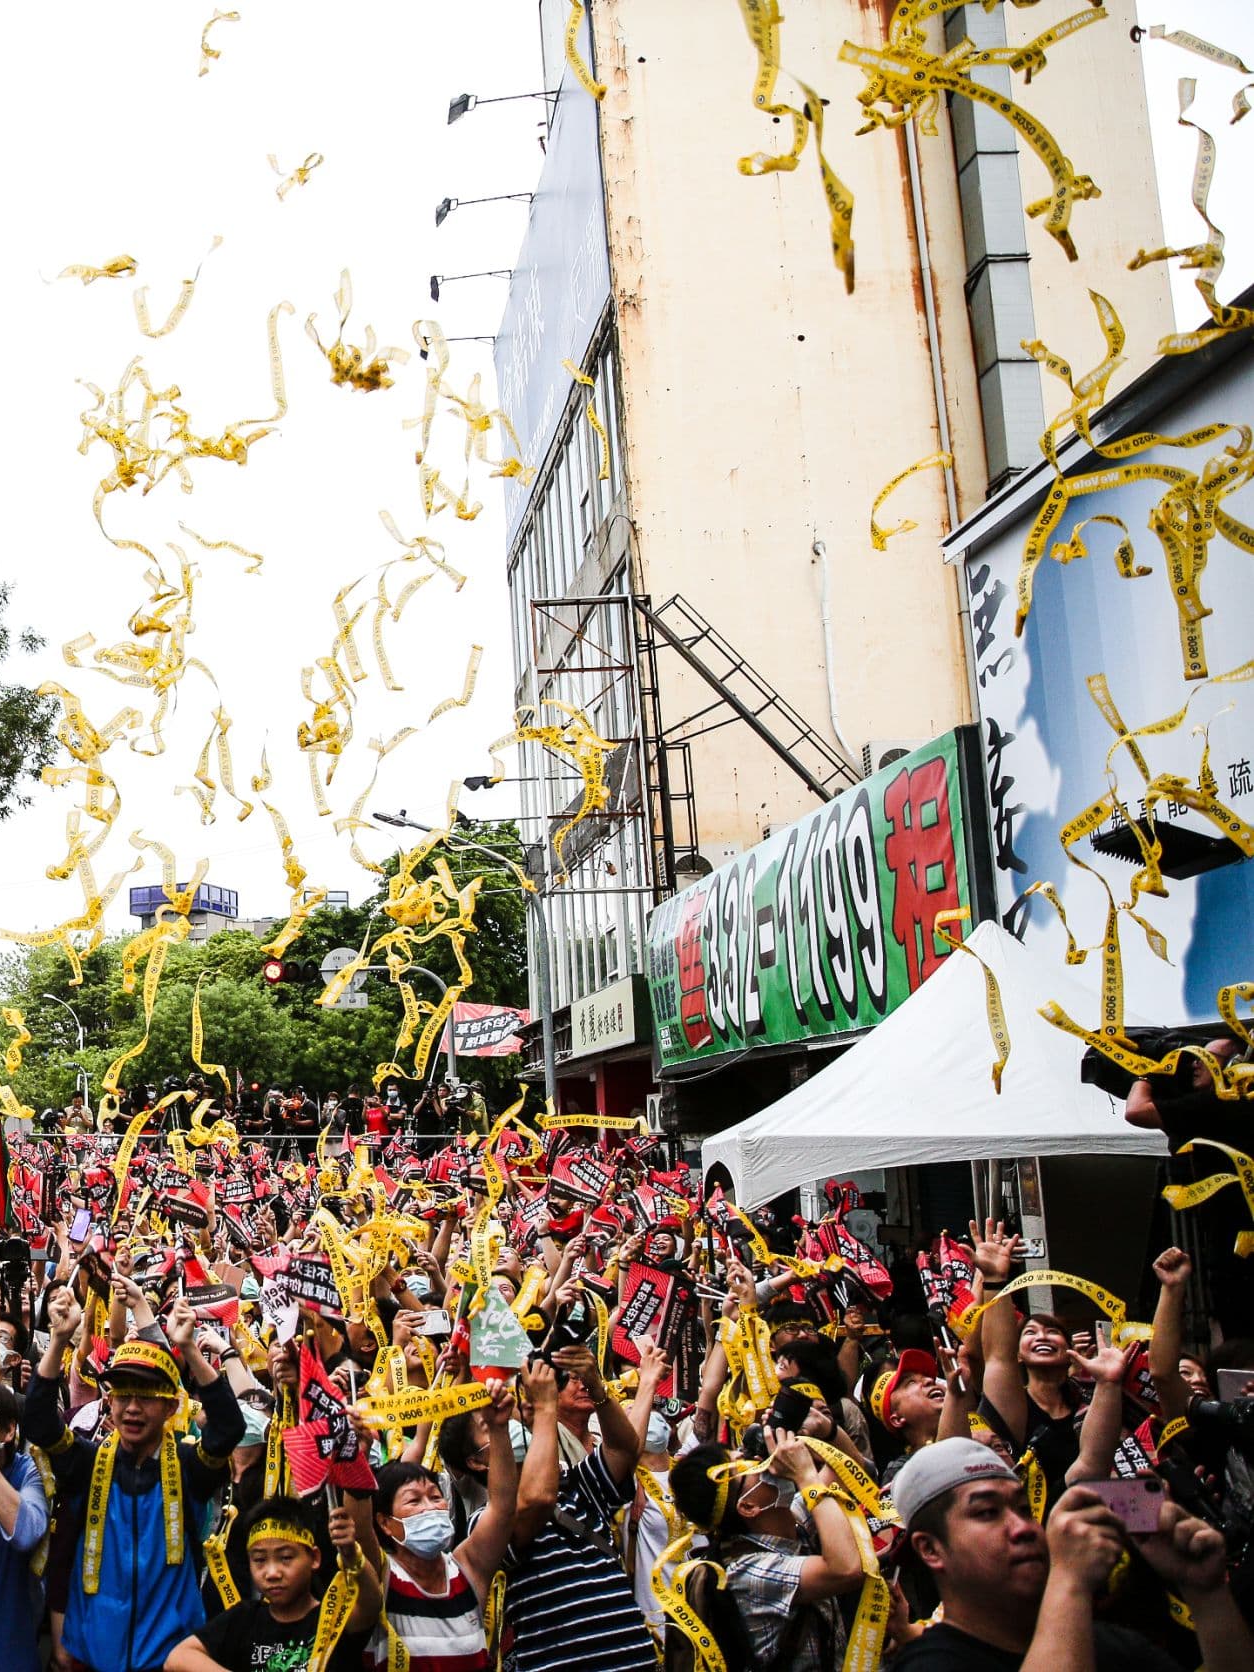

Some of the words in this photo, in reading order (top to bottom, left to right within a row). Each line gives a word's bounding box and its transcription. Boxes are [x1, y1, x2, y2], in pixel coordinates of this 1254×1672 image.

[703, 788, 887, 1043] 332-1199
[1107, 913, 1116, 939] 2020
[1106, 995, 1116, 1021] 0606
[119, 1346, 141, 1358] 2020
[878, 1373, 891, 1391] 2020
[399, 1408, 423, 1420] 0606
[167, 1442, 176, 1462] 0606
[91, 1485, 103, 1510] 0606
[169, 1501, 179, 1518] We
[170, 1519, 180, 1548] Vote
[673, 1605, 700, 1634] 0606
